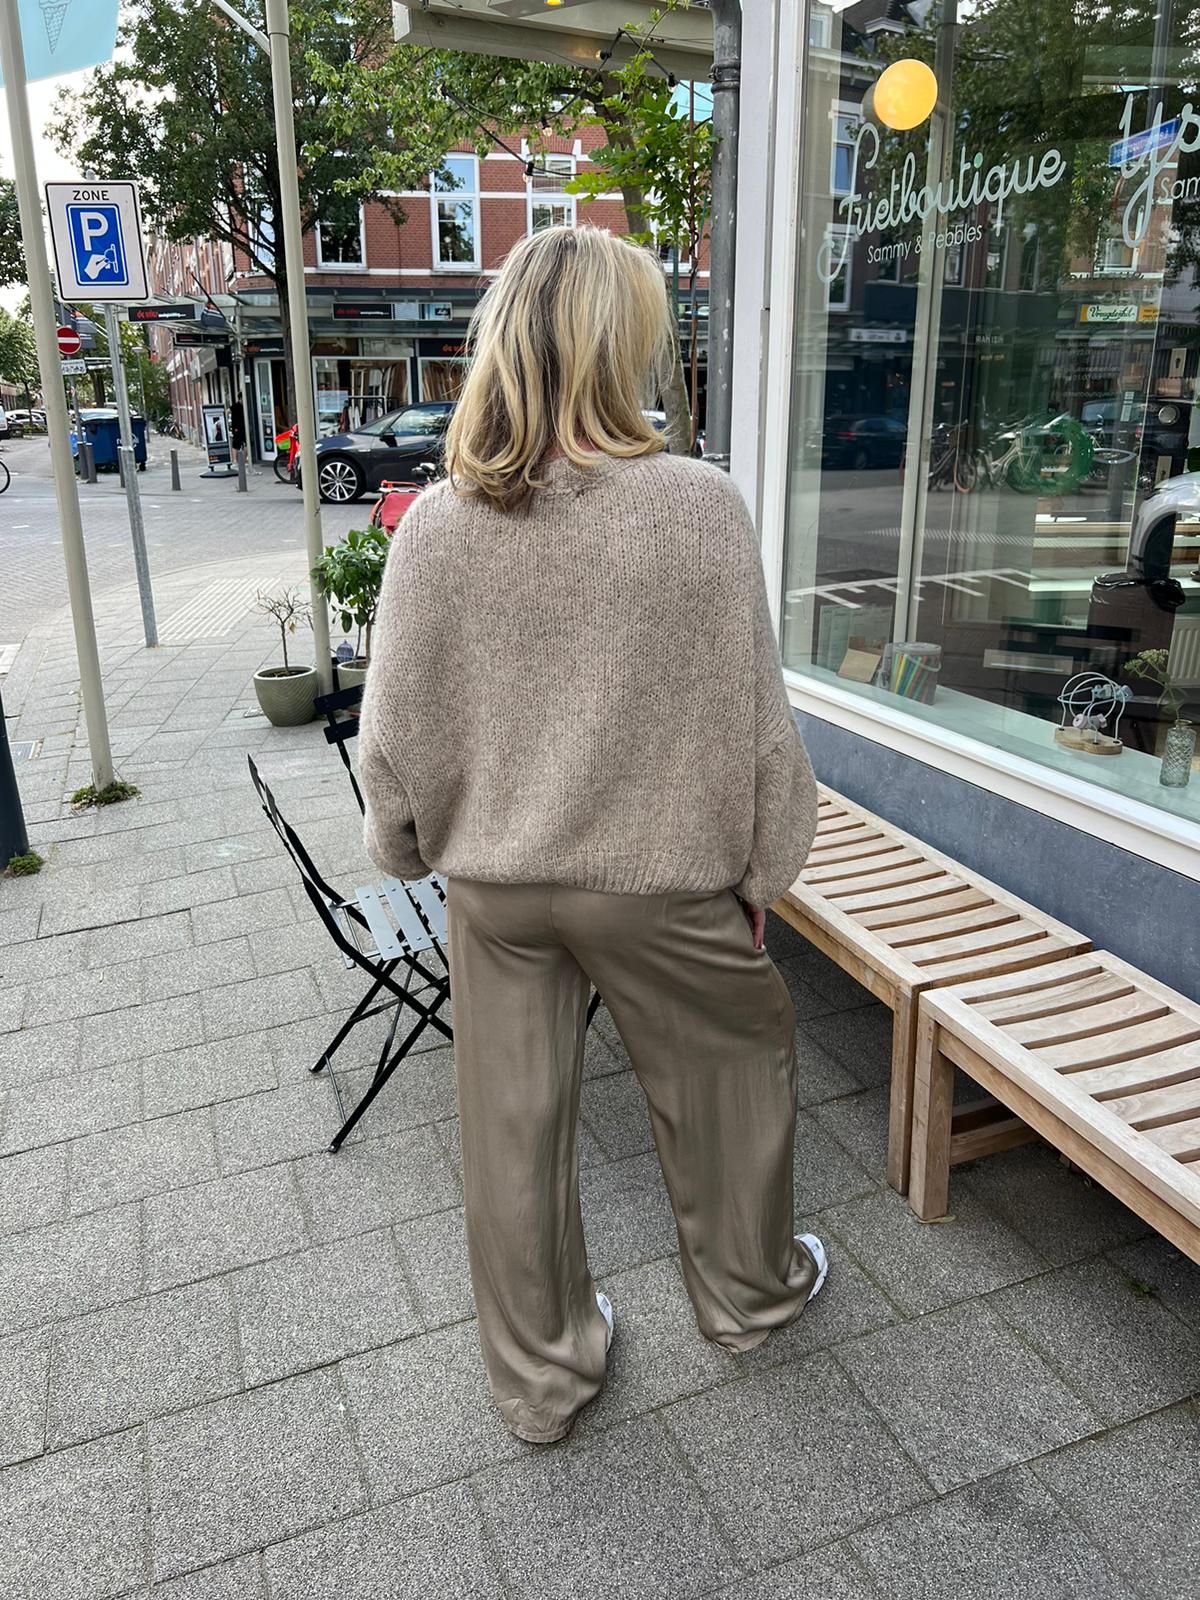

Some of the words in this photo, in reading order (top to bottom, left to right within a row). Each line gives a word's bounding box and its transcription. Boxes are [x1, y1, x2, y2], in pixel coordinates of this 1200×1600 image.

[72, 189, 110, 202] ZONE
[816, 122, 1067, 284] Frietboutique
[79, 211, 109, 251] P
[866, 238, 911, 265] Sammy
[914, 235, 923, 255] &
[929, 223, 983, 250] Pebbles
